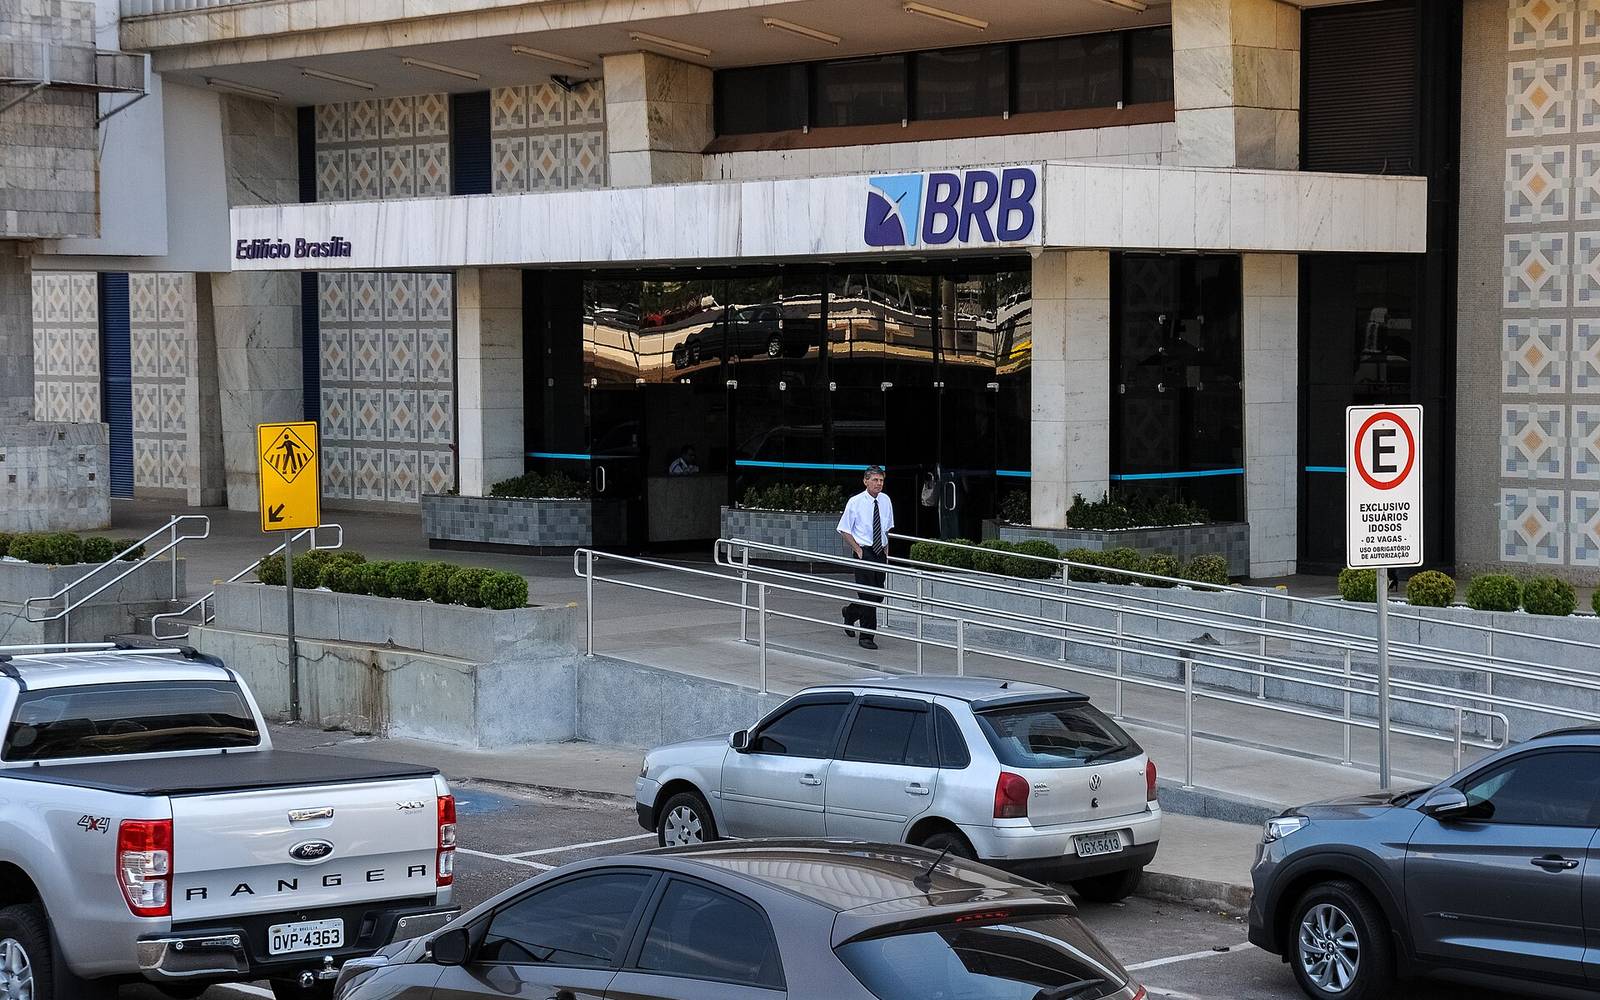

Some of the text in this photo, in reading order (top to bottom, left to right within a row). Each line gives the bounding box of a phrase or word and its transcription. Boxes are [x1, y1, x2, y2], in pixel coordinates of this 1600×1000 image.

[922, 168, 1037, 245] BRB
[235, 236, 352, 260] Edifício Brasília
[1372, 428, 1397, 473] E
[1359, 502, 1411, 512] EXCLUSIVO
[1361, 511, 1409, 523] USUÁRIOS
[1368, 522, 1402, 533] IDOSOS
[1365, 536, 1375, 544] 02
[1377, 534, 1403, 543] VAGAS
[301, 843, 326, 857] Ford
[186, 864, 427, 901] RANGER
